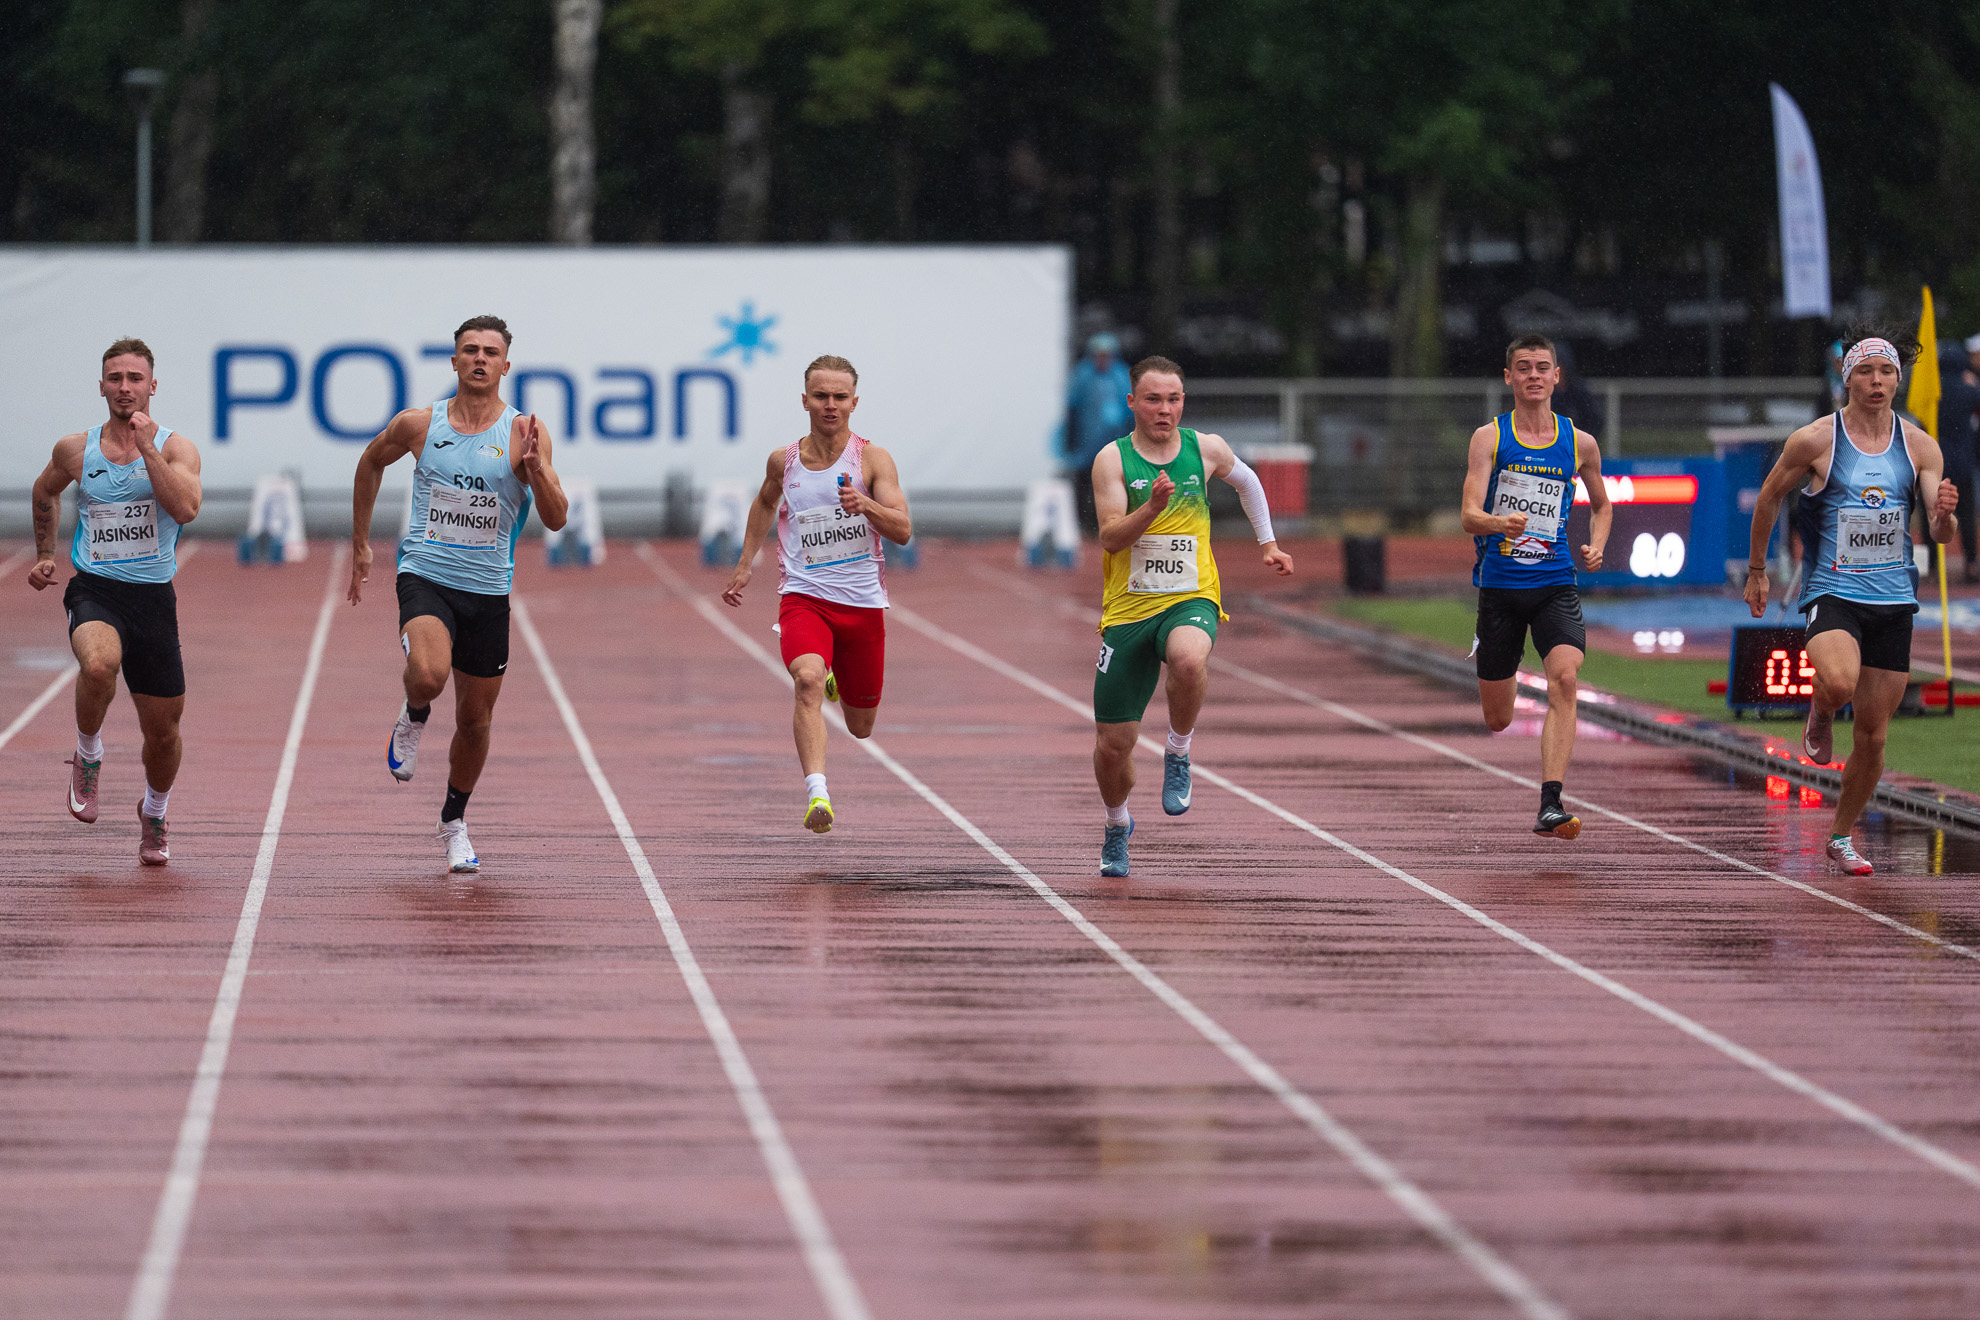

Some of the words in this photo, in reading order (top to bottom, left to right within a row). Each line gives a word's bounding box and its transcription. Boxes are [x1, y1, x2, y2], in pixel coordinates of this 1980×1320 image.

[212, 342, 740, 442] POnan
[1508, 464, 1563, 476] KRUSZWICA
[1129, 478, 1149, 490] 4F
[1537, 481, 1560, 497] 103
[469, 495, 497, 508] 236
[1499, 493, 1557, 518] PROCEK
[124, 505, 151, 519] 237
[429, 508, 498, 529] DYMIŃSKI
[1879, 511, 1900, 525] 874
[92, 524, 155, 543] JASIŃSKI
[801, 523, 867, 548] KULPIŃSKI
[1849, 528, 1896, 547] KMIEĆ
[1170, 539, 1193, 552] 551
[1145, 559, 1184, 574] PRUS
